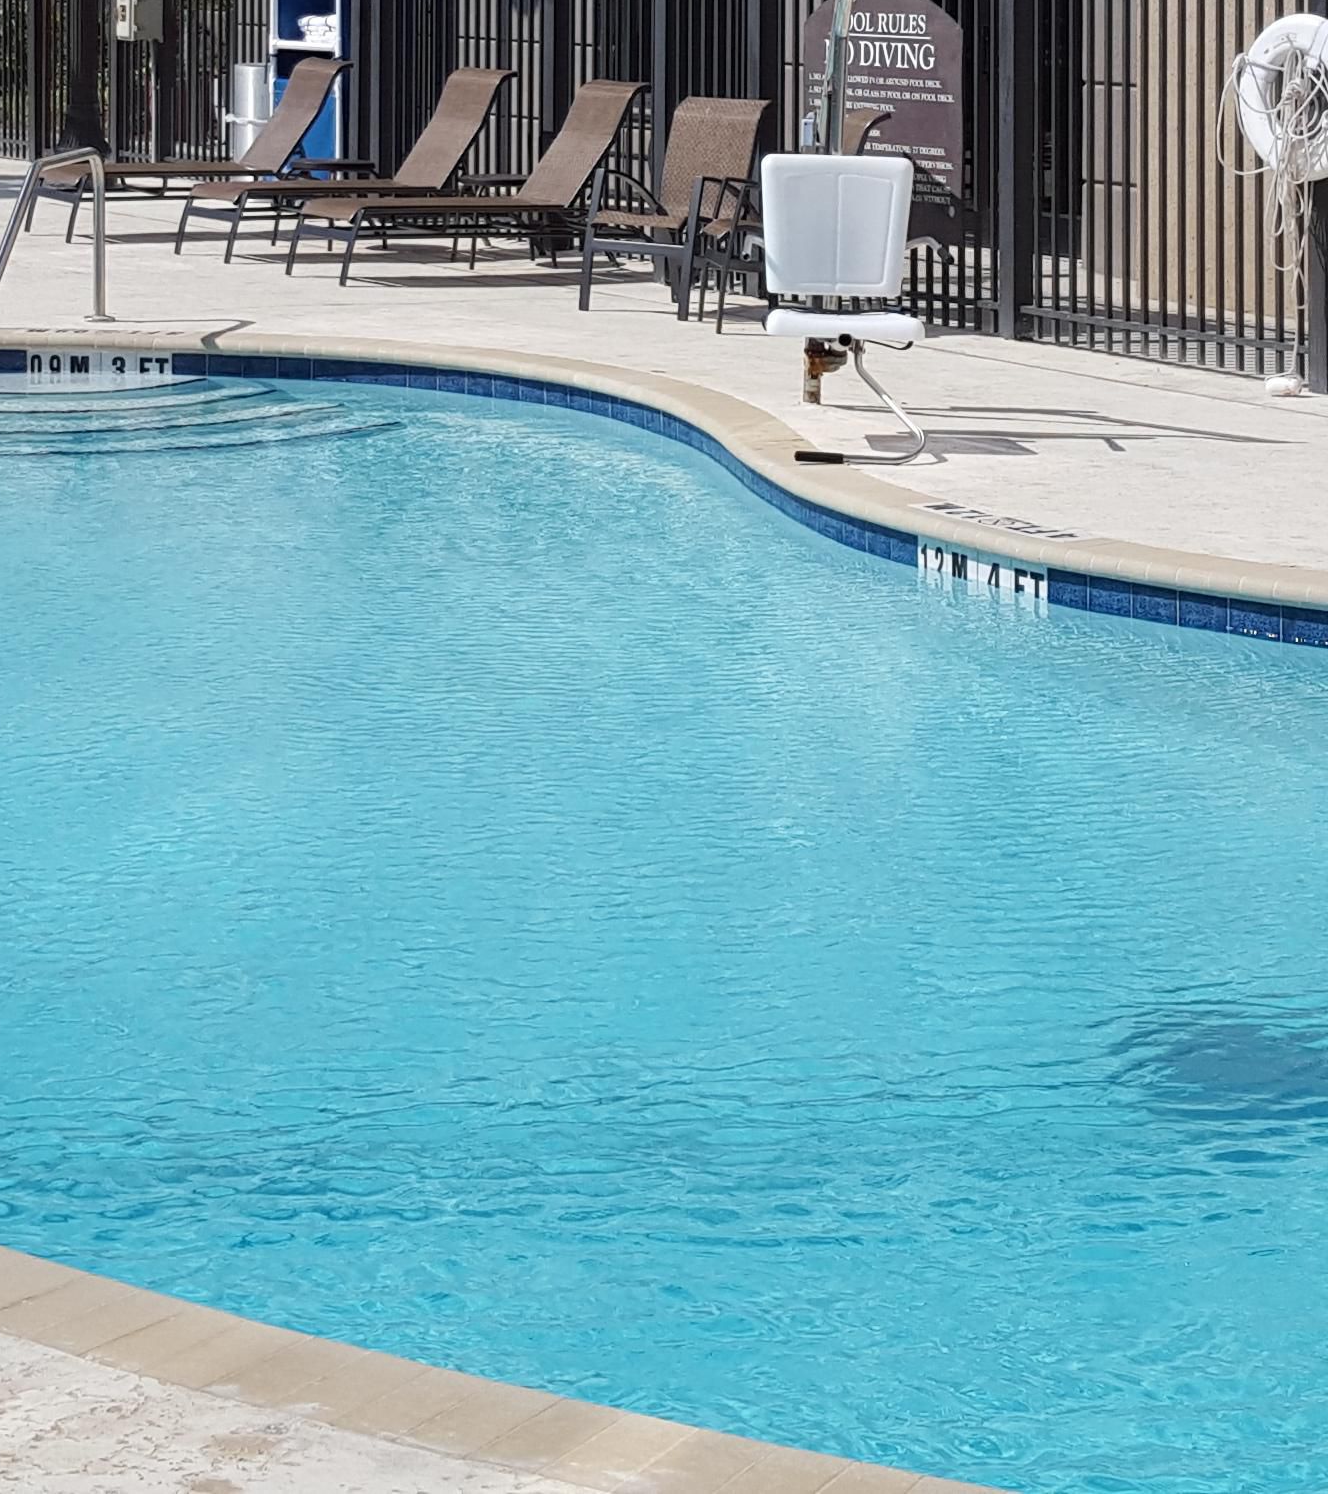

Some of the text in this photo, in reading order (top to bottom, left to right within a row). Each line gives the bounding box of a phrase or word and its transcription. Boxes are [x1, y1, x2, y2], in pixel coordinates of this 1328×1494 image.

[877, 12, 926, 34] RULES
[859, 40, 936, 71] DIVING
[69, 355, 90, 374] M
[111, 356, 126, 375] 3
[139, 357, 170, 375] FT
[951, 552, 969, 581] M
[1014, 567, 1045, 600] FT
